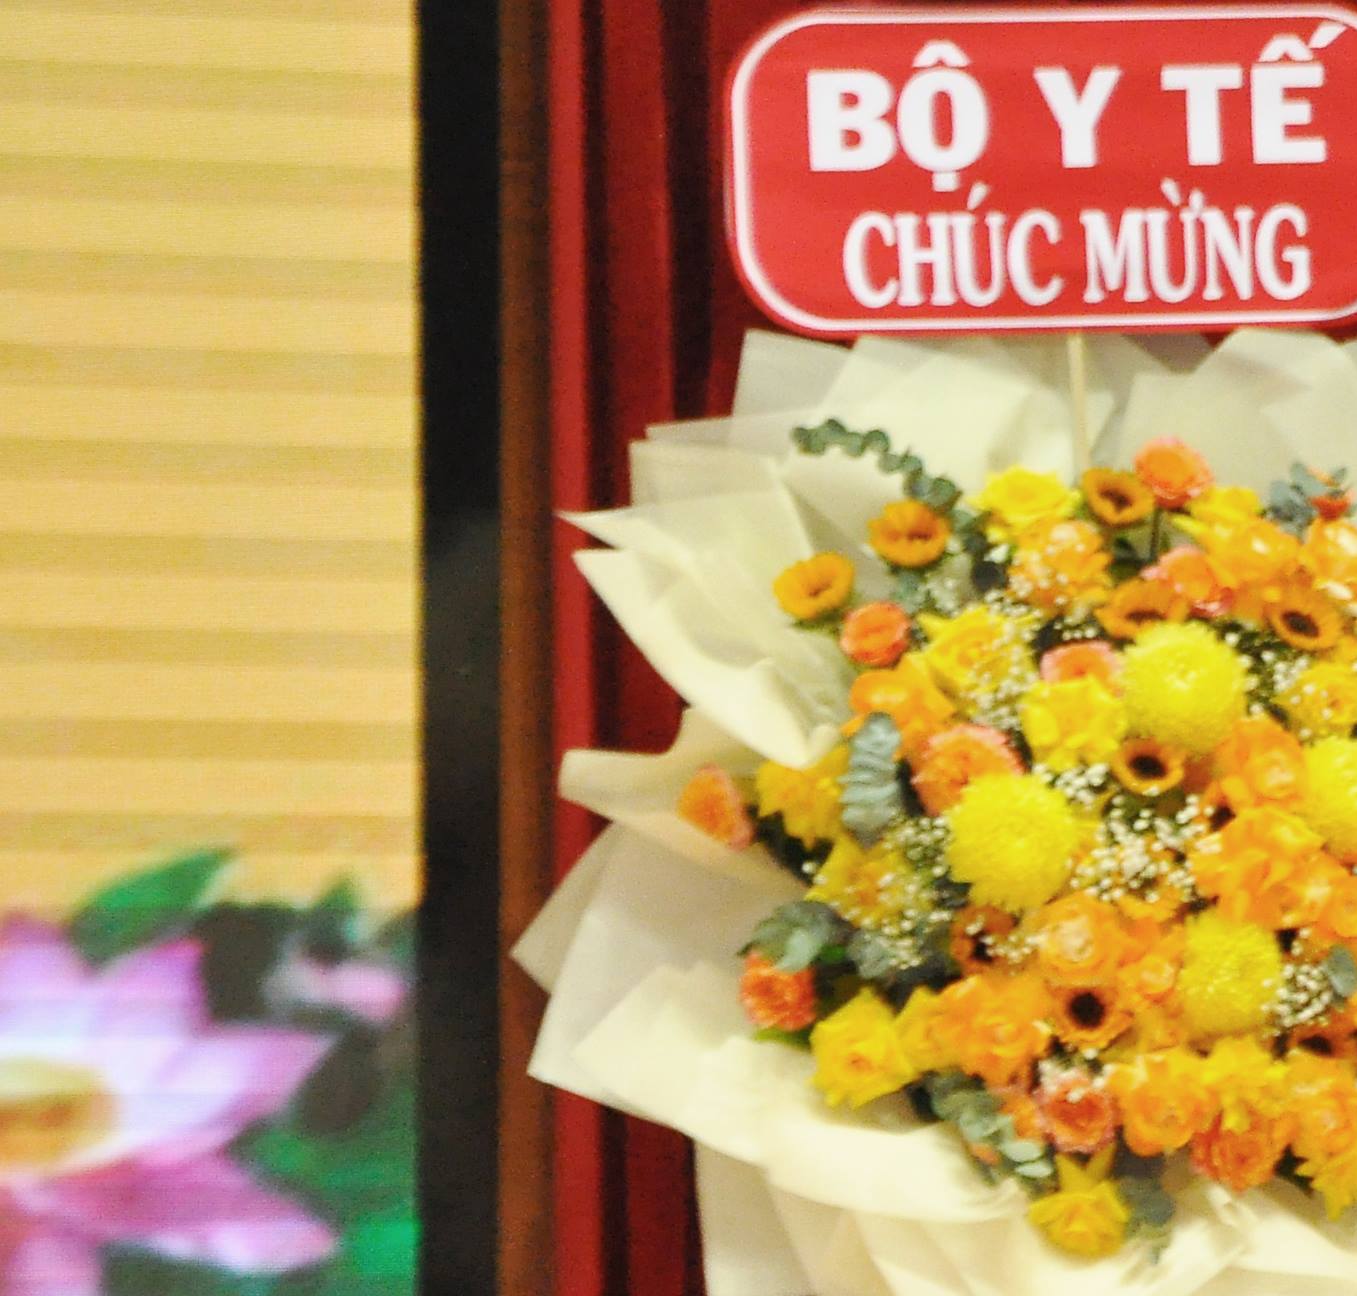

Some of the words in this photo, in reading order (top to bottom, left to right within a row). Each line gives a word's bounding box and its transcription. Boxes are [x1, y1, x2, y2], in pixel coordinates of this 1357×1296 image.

[806, 39, 990, 192] BỘ
[1032, 65, 1122, 169] Y
[1159, 22, 1347, 166] TẾ
[842, 181, 1063, 308] CHÚC
[1079, 177, 1312, 304] MỪNG
